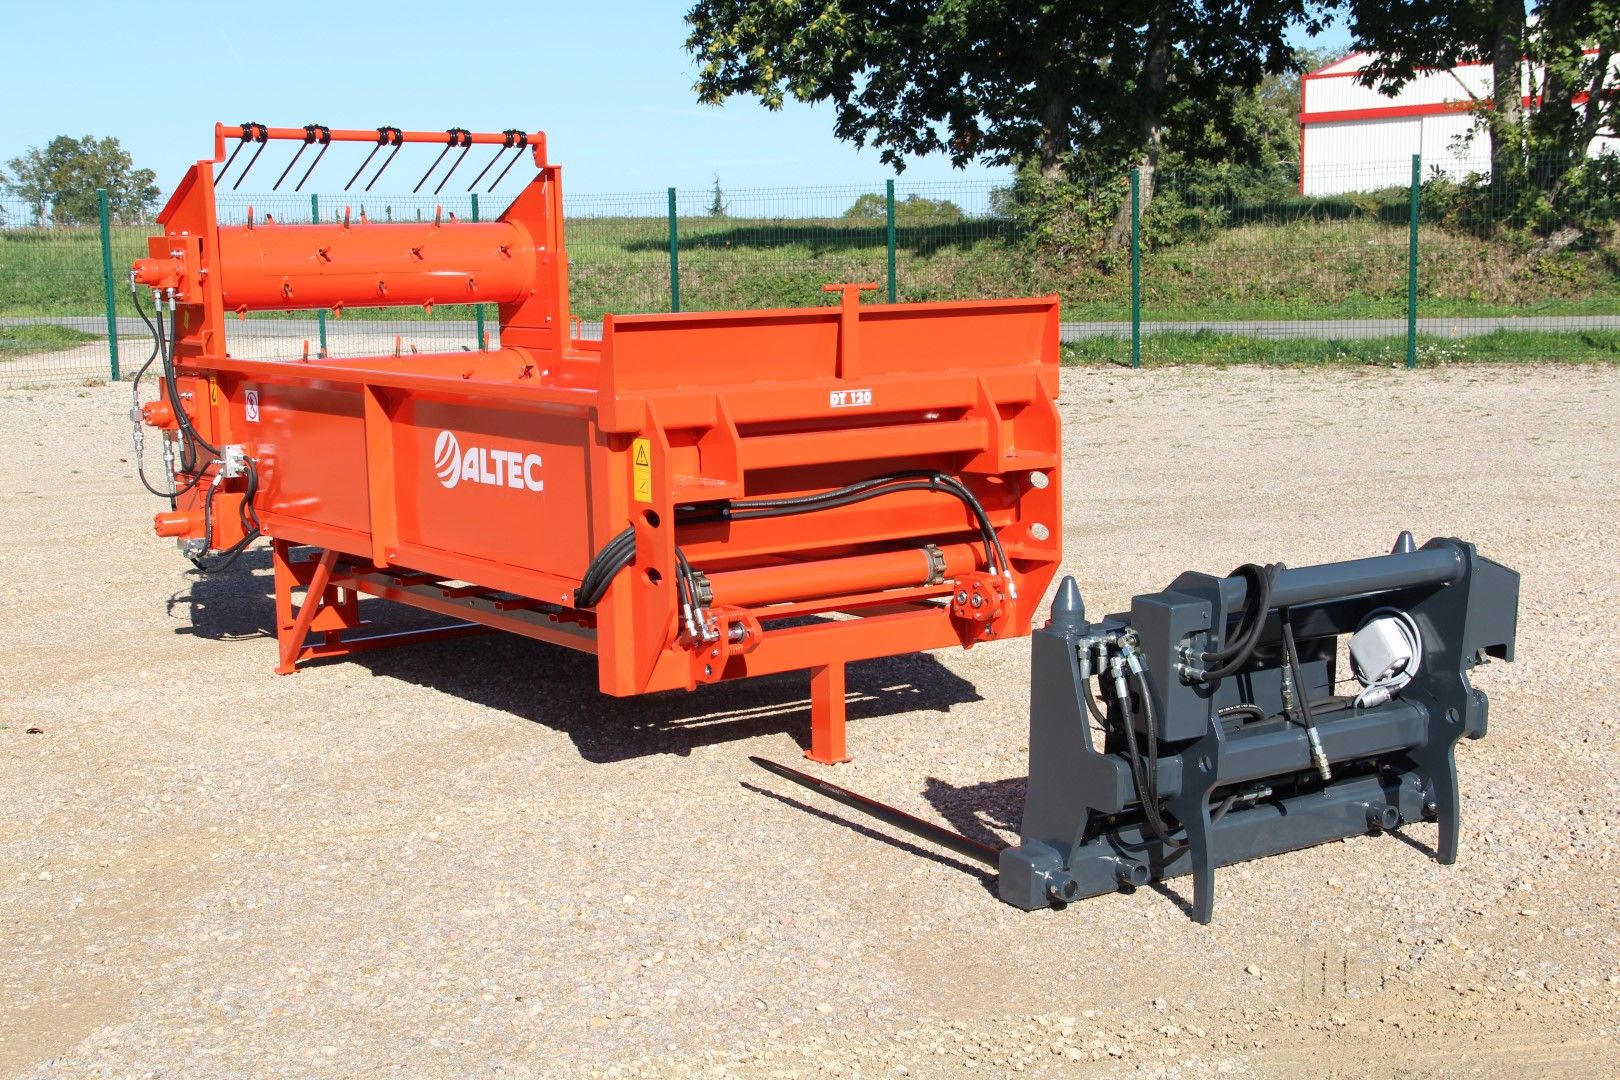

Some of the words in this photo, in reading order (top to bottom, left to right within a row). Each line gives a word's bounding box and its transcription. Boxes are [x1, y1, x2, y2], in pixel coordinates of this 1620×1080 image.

[830, 392, 847, 405] DT
[851, 391, 872, 404] 120
[461, 447, 544, 492] ALTEC
